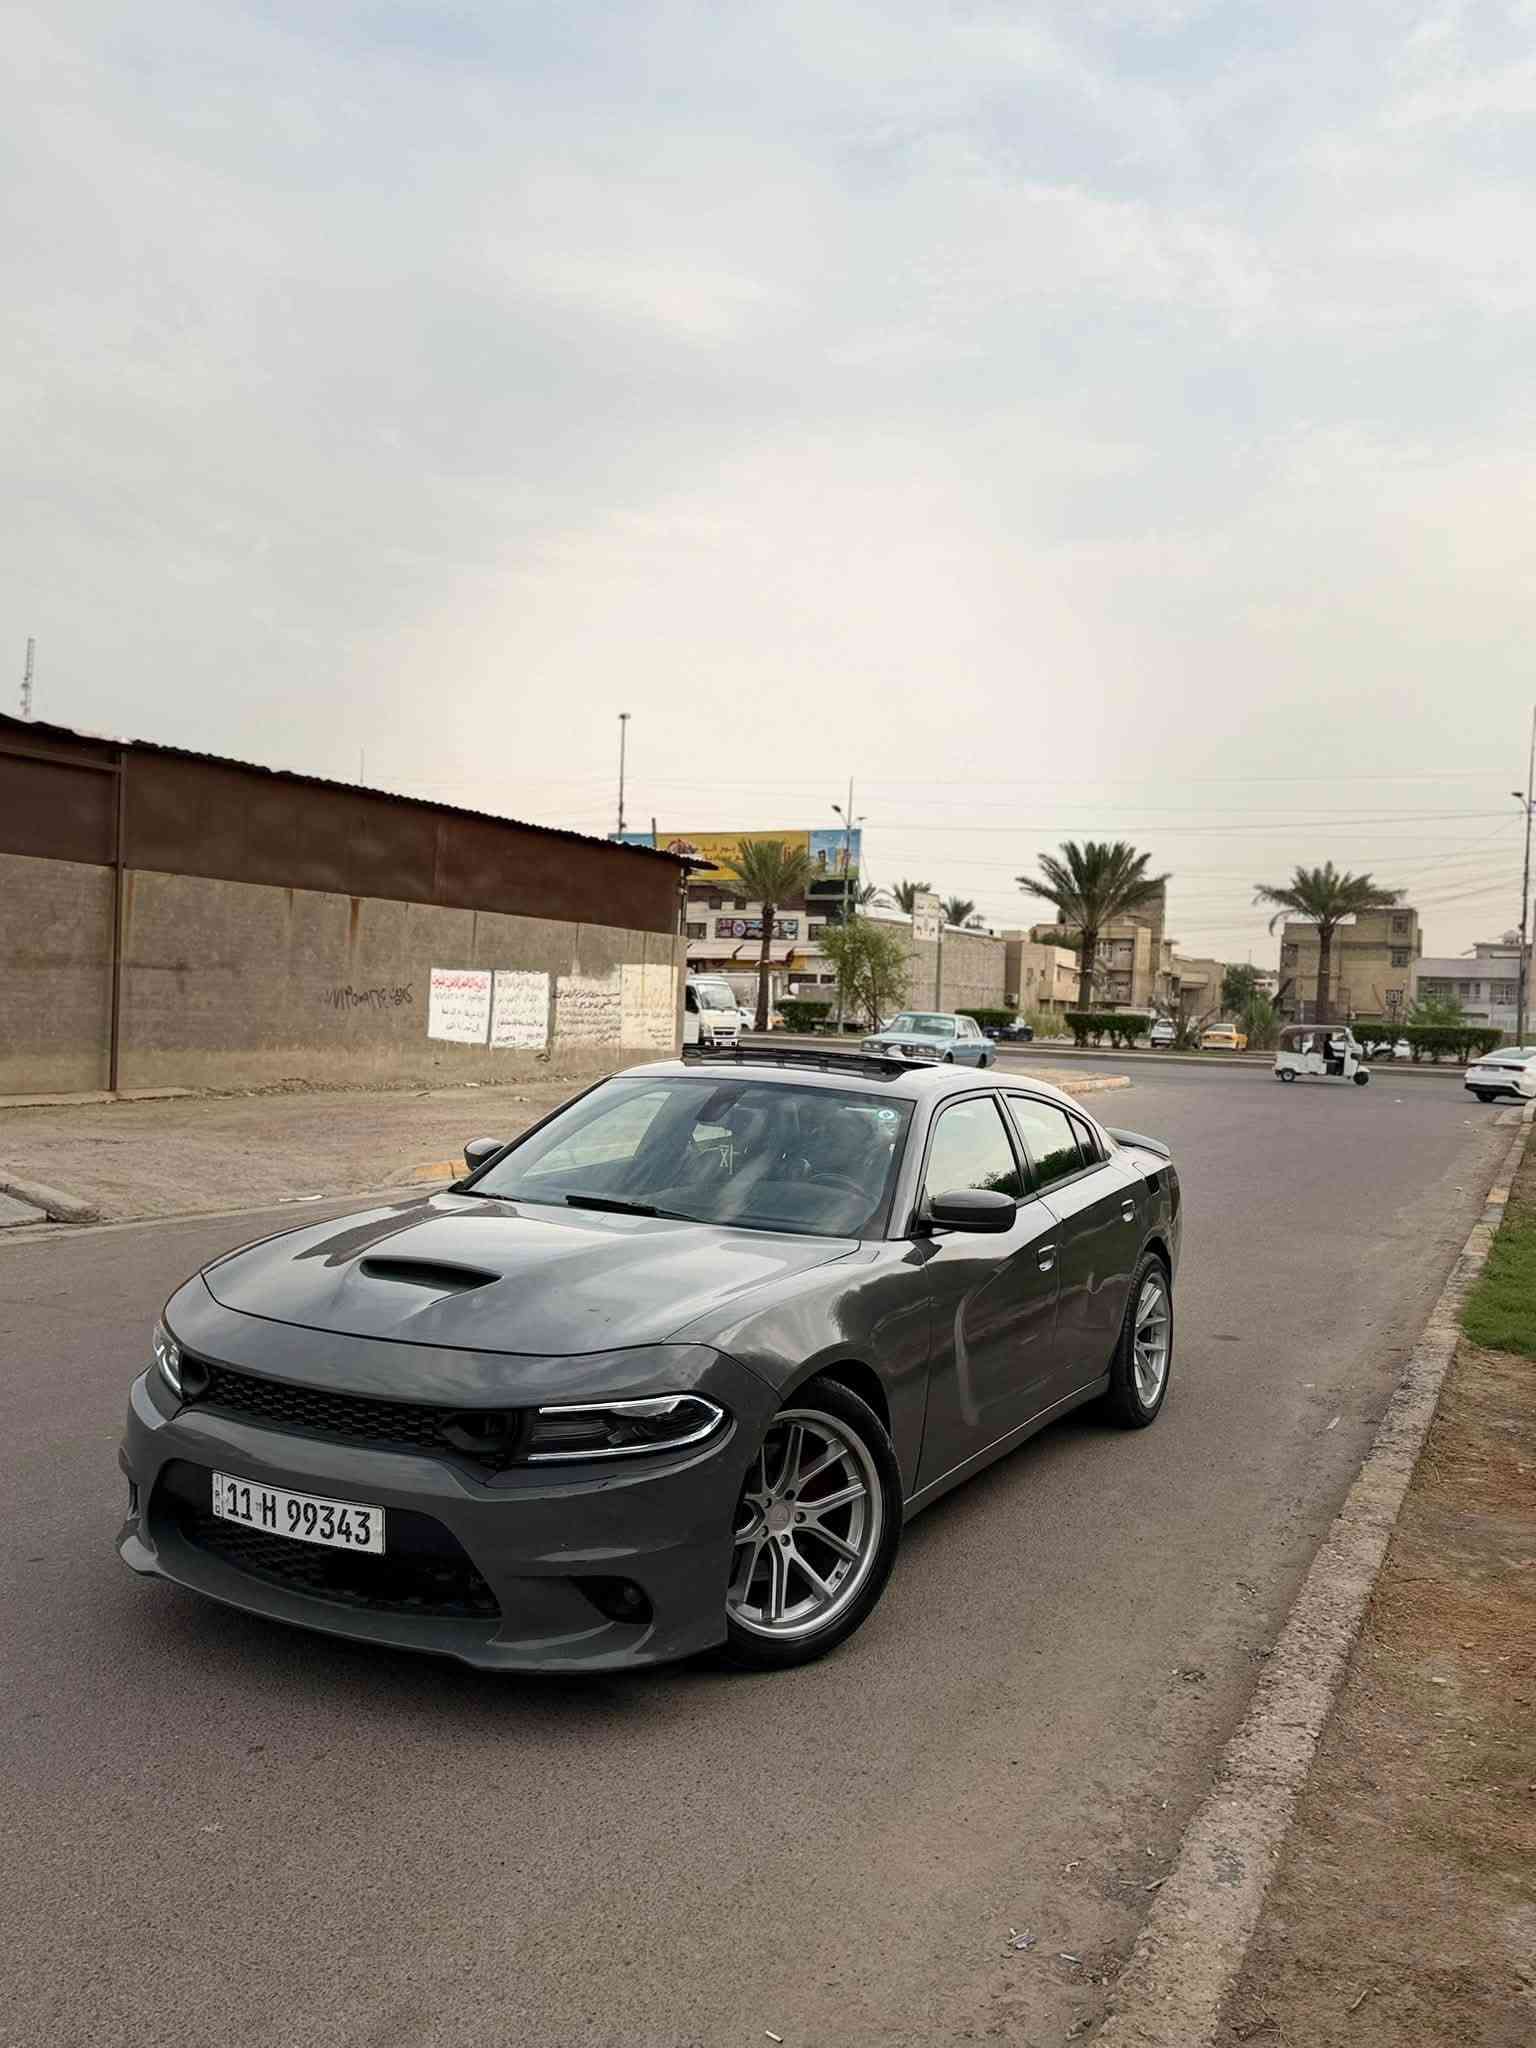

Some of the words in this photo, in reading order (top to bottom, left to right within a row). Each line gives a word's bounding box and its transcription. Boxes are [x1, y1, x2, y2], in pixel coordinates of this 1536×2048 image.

[227, 1483, 253, 1521] 11
[262, 1492, 276, 1528] H
[287, 1500, 371, 1545] 99343
